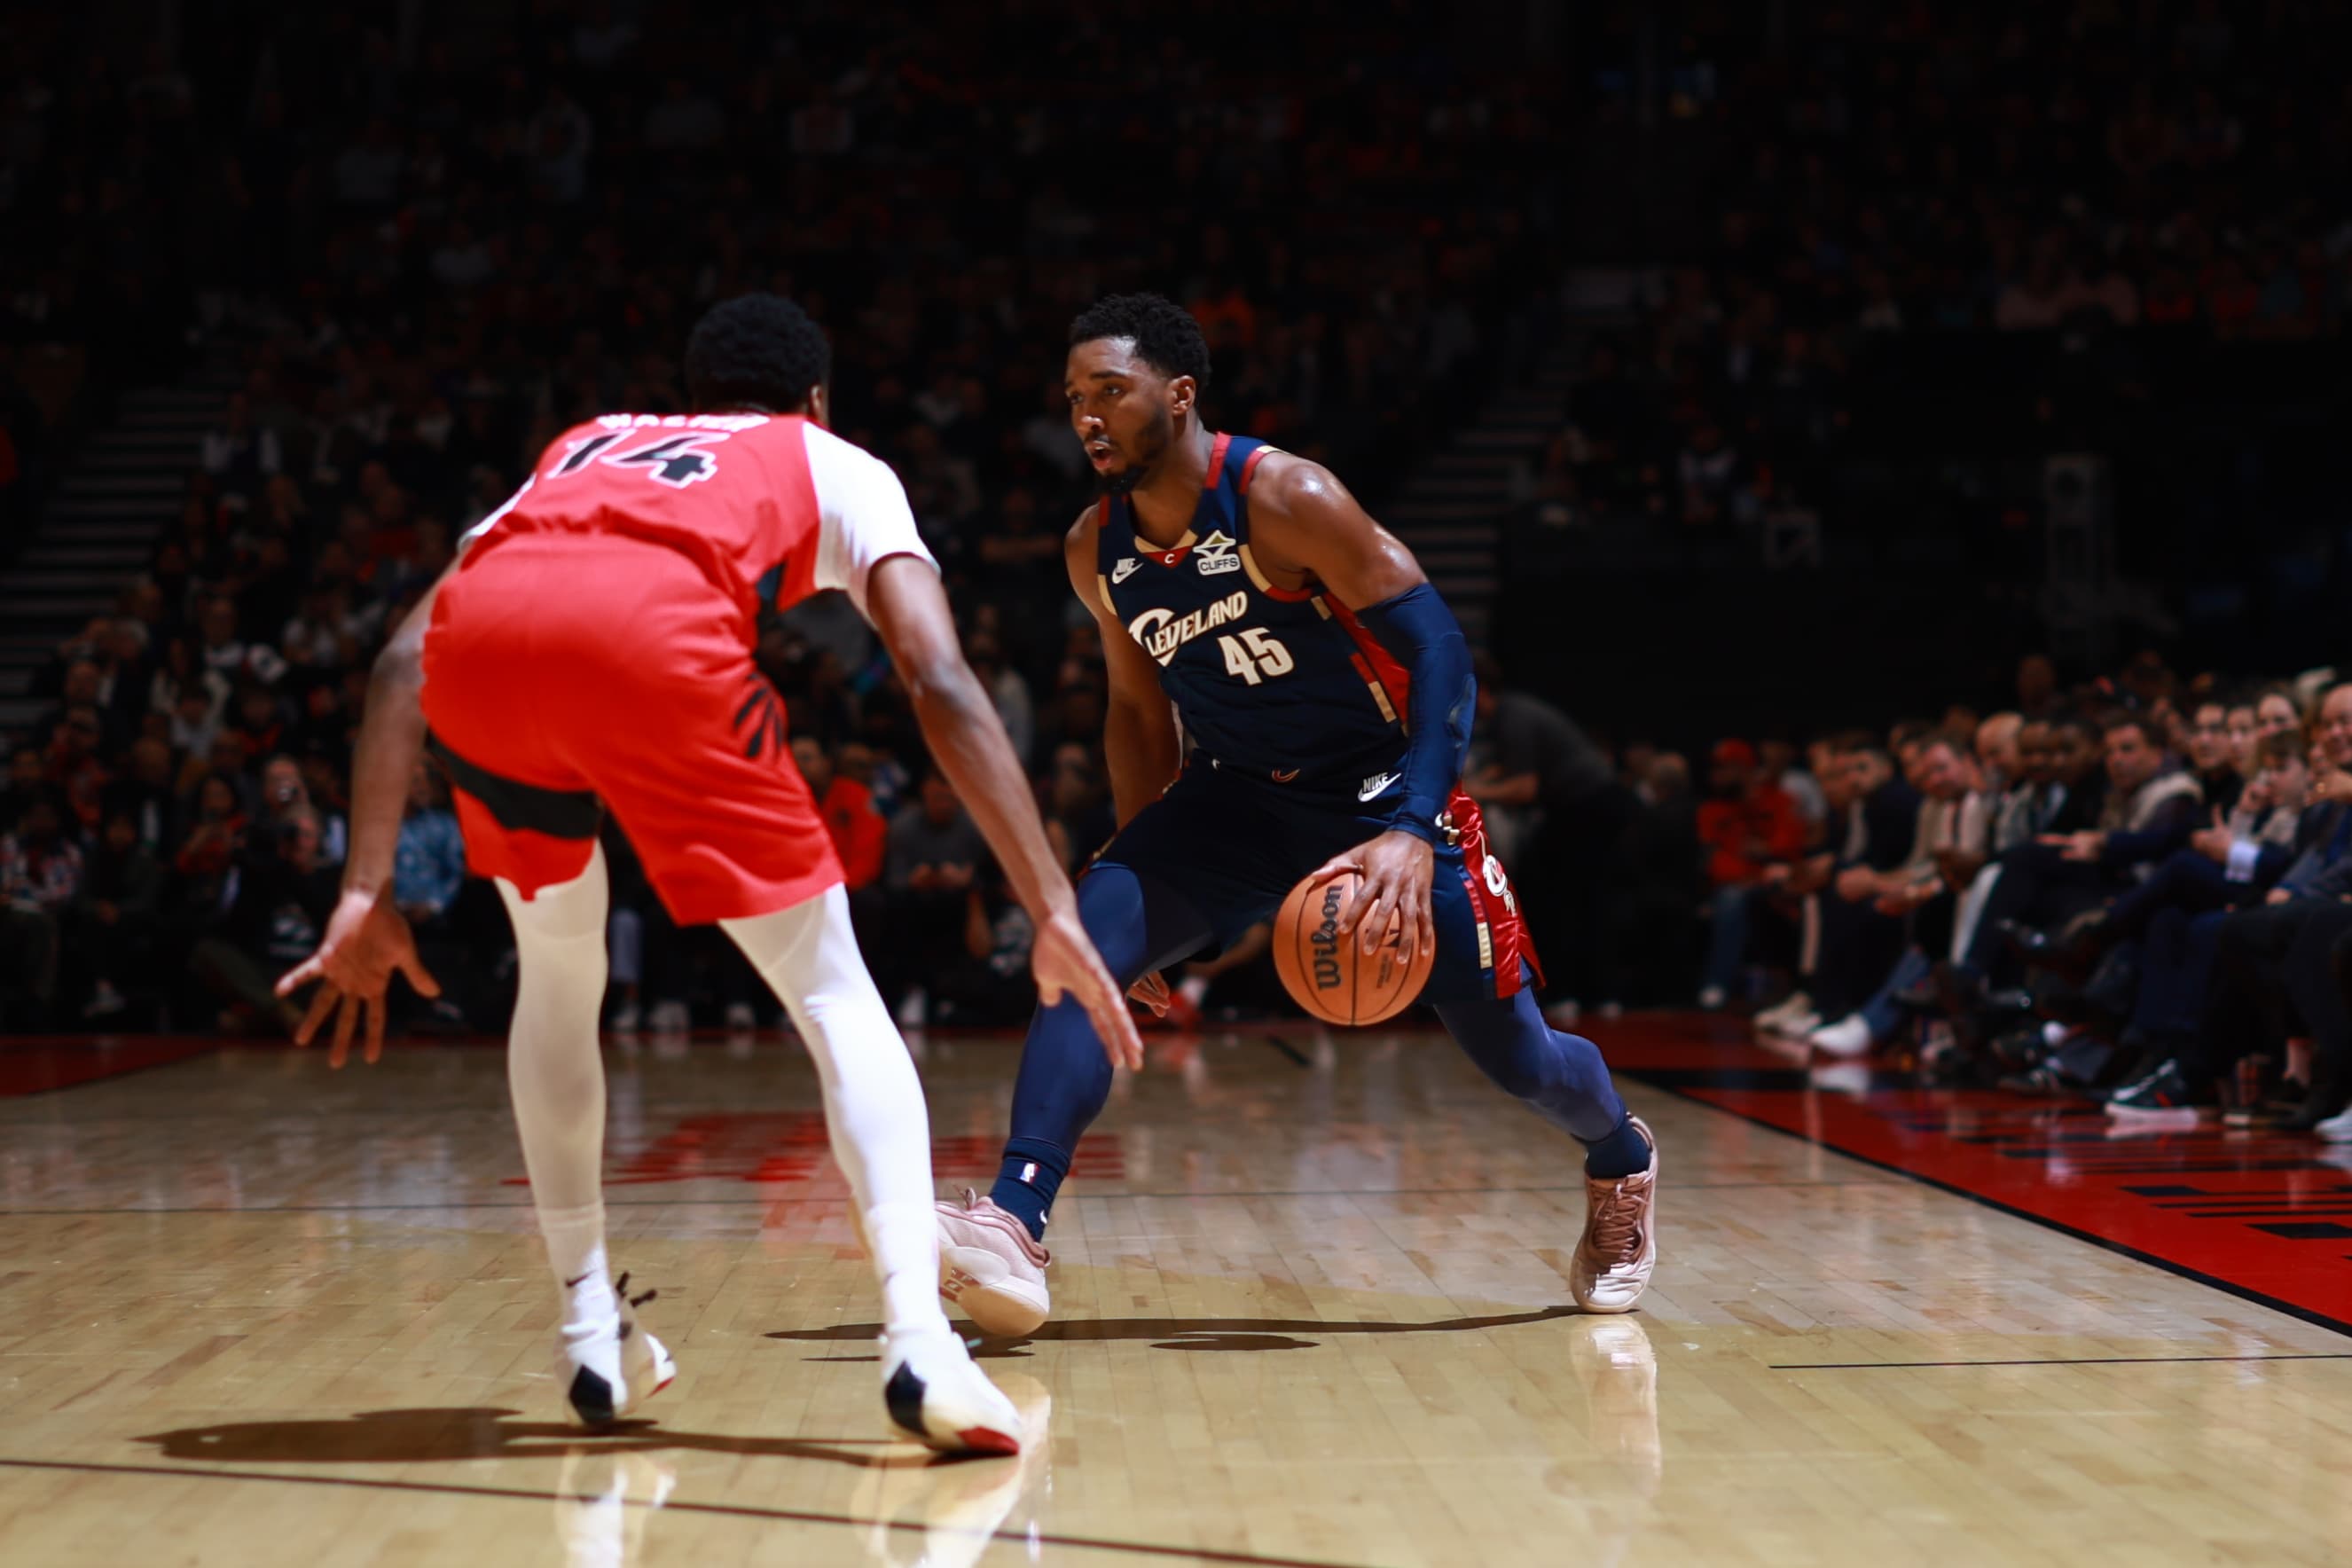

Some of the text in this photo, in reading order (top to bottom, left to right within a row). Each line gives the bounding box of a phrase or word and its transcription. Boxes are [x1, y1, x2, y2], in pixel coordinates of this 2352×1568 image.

[544, 427, 731, 489] 14
[1199, 556, 1238, 572] CLIFFS
[1128, 591, 1248, 667] CLEVELAND
[1217, 626, 1295, 686] 45
[1362, 772, 1389, 793] NIKE
[1310, 884, 1345, 992] Wilson
